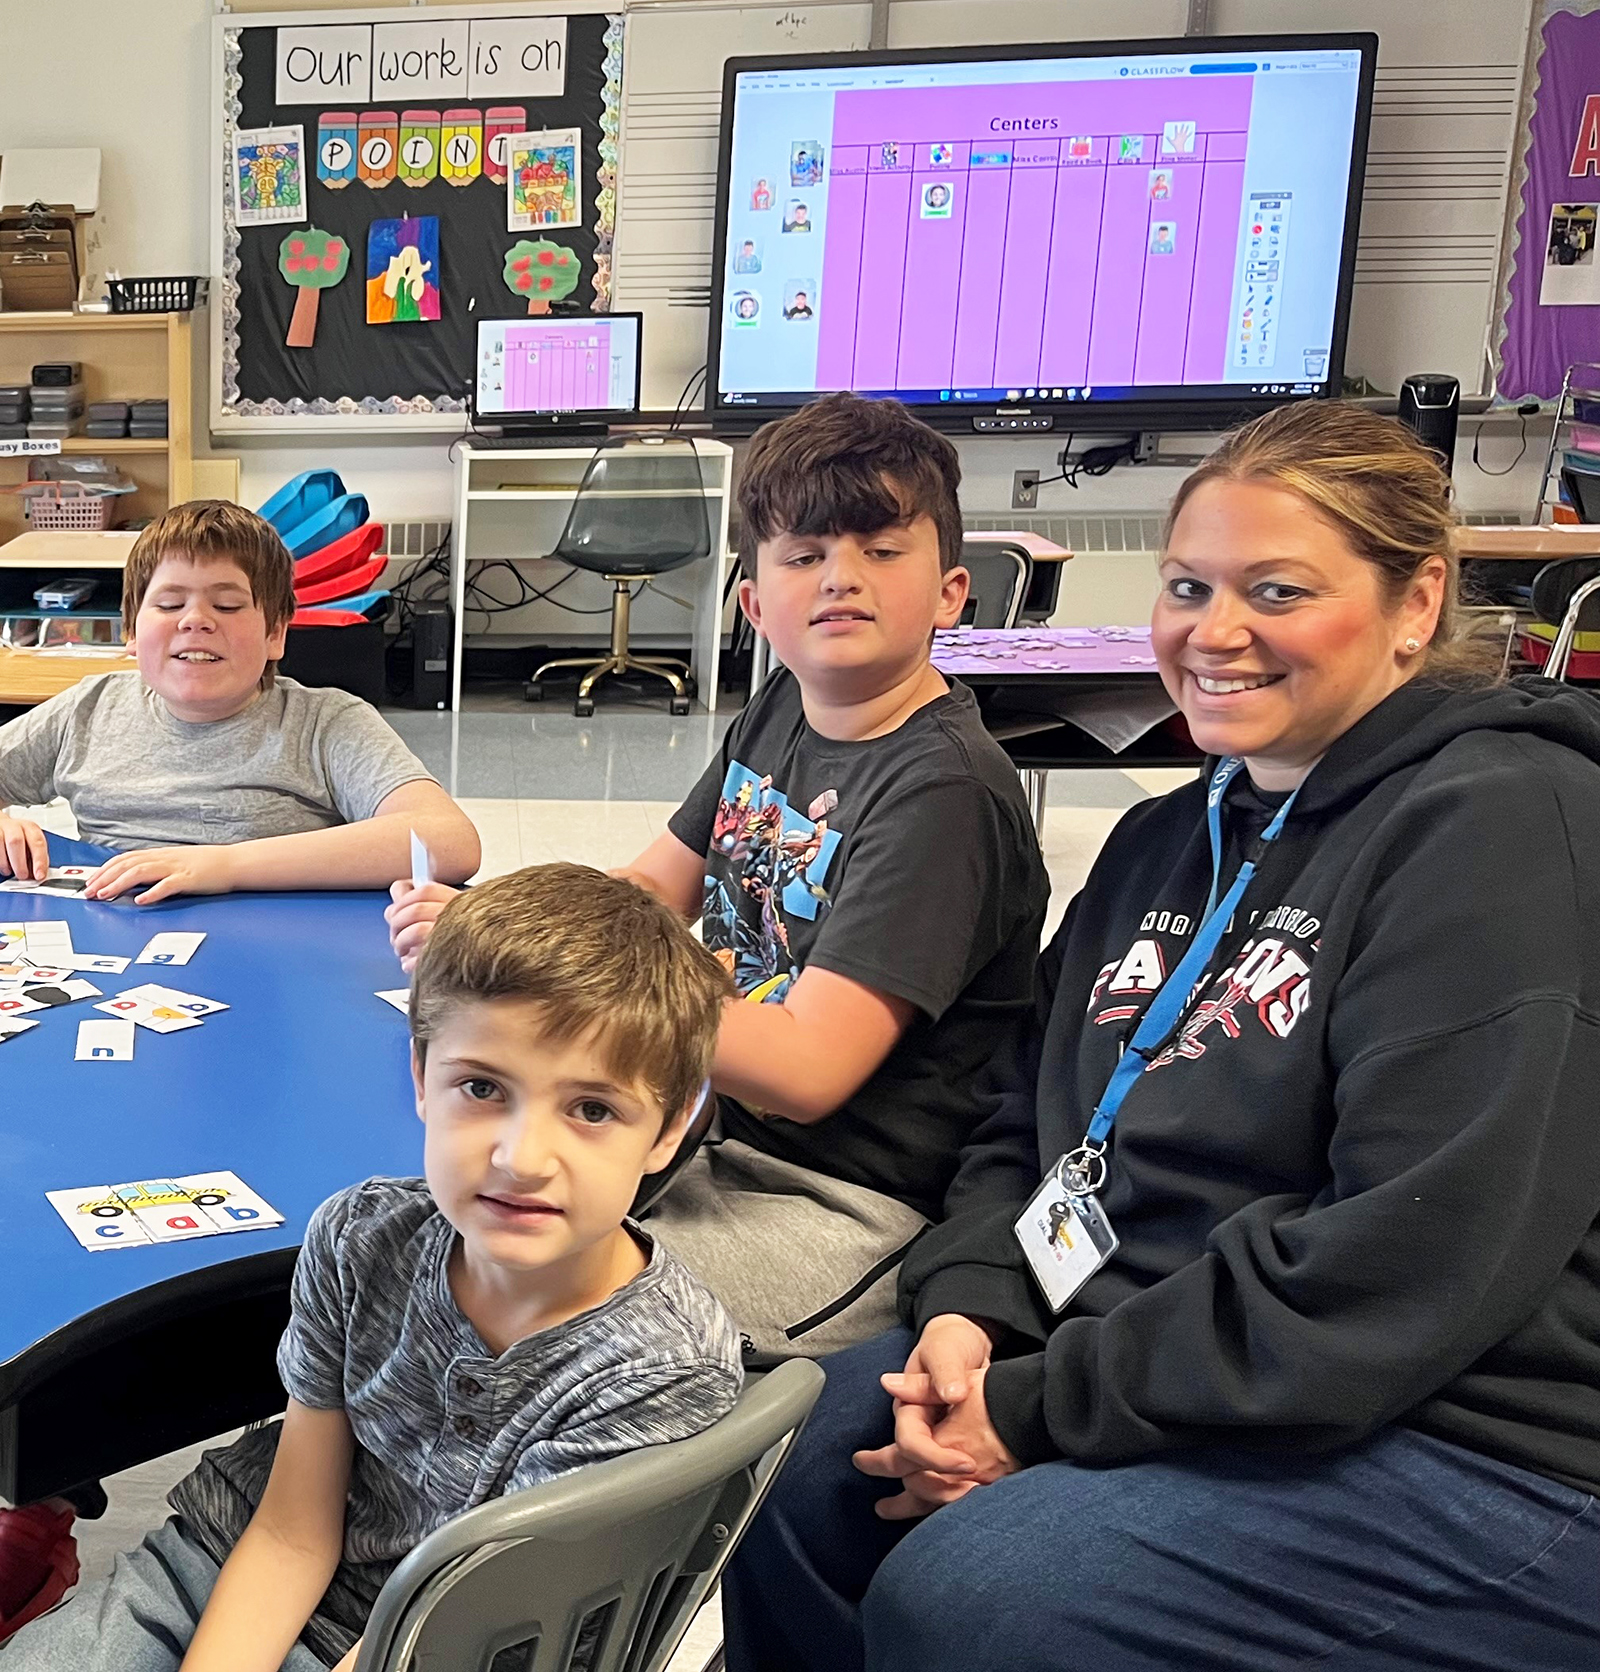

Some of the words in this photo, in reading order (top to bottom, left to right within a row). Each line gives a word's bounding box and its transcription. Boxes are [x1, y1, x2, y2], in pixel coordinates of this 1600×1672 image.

[286, 46, 363, 87] Our
[379, 37, 463, 82] work
[475, 41, 502, 76] is
[520, 38, 561, 72] on
[989, 117, 1059, 132] Centers
[22, 442, 59, 451] Boxes
